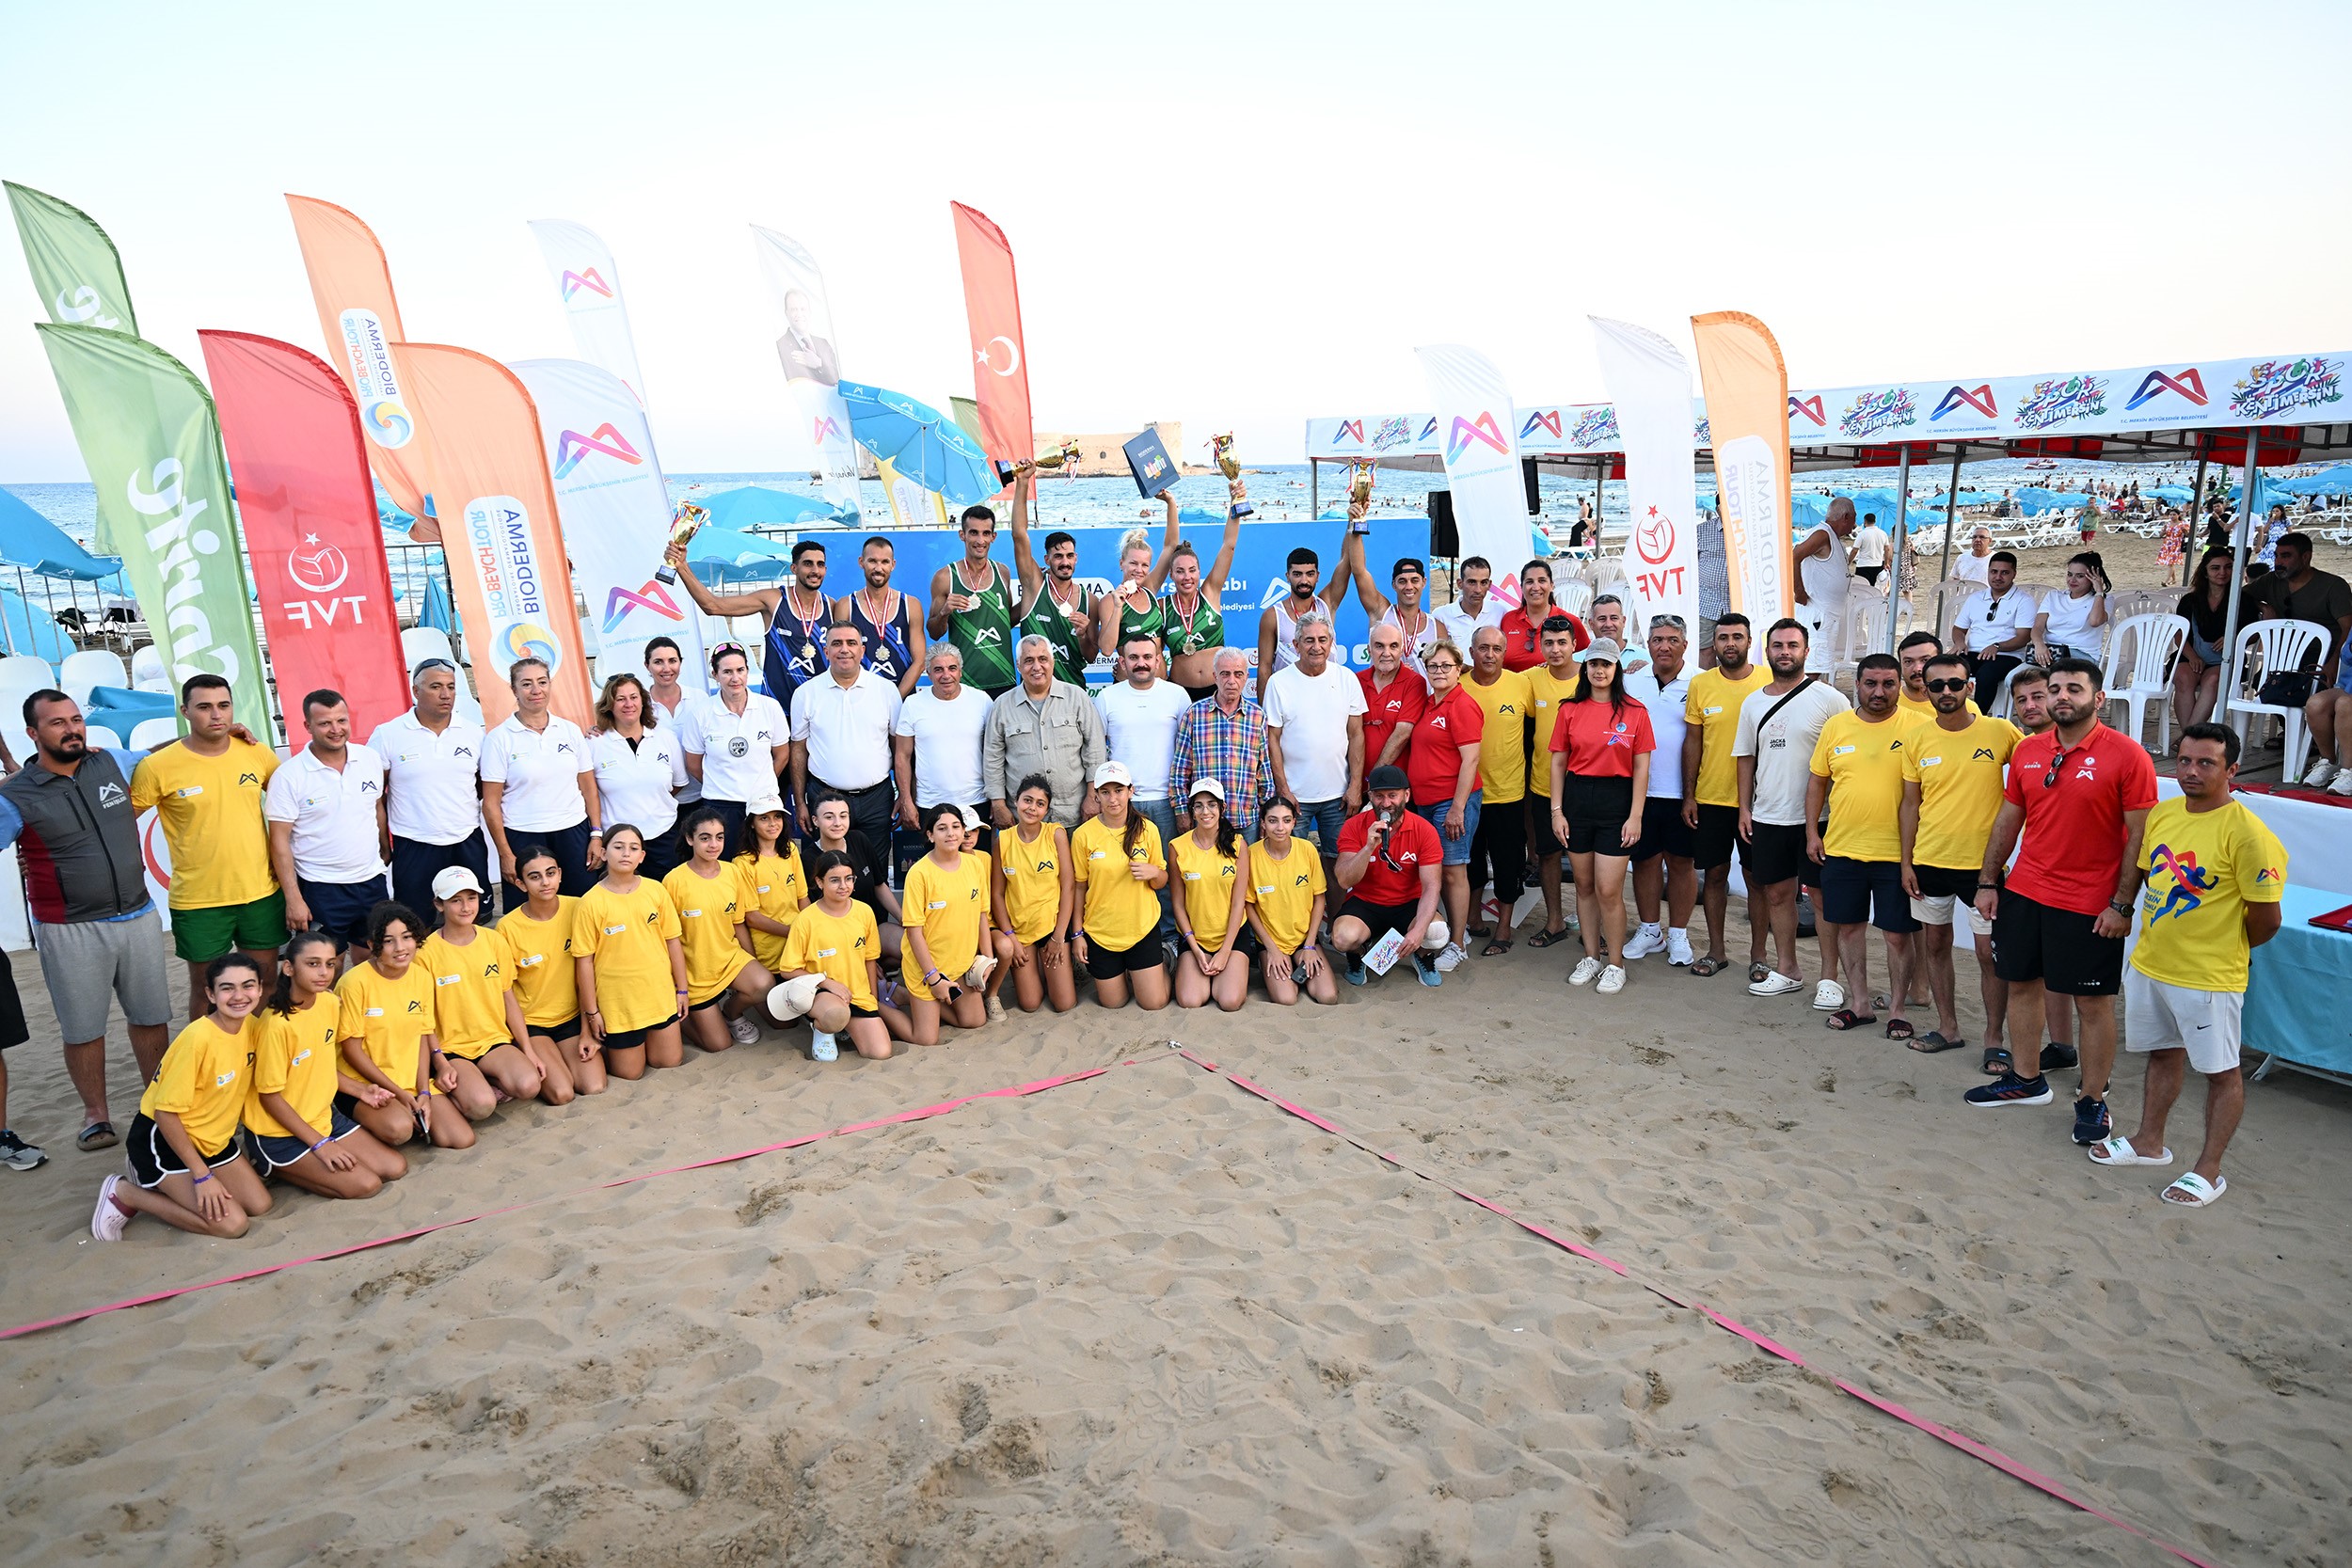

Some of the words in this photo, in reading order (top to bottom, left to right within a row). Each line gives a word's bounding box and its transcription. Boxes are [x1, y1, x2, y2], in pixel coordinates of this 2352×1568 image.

[996, 593, 1005, 610] 1
[1205, 610, 1216, 626] 2
[818, 626, 828, 643] 2
[896, 626, 903, 644] 1
